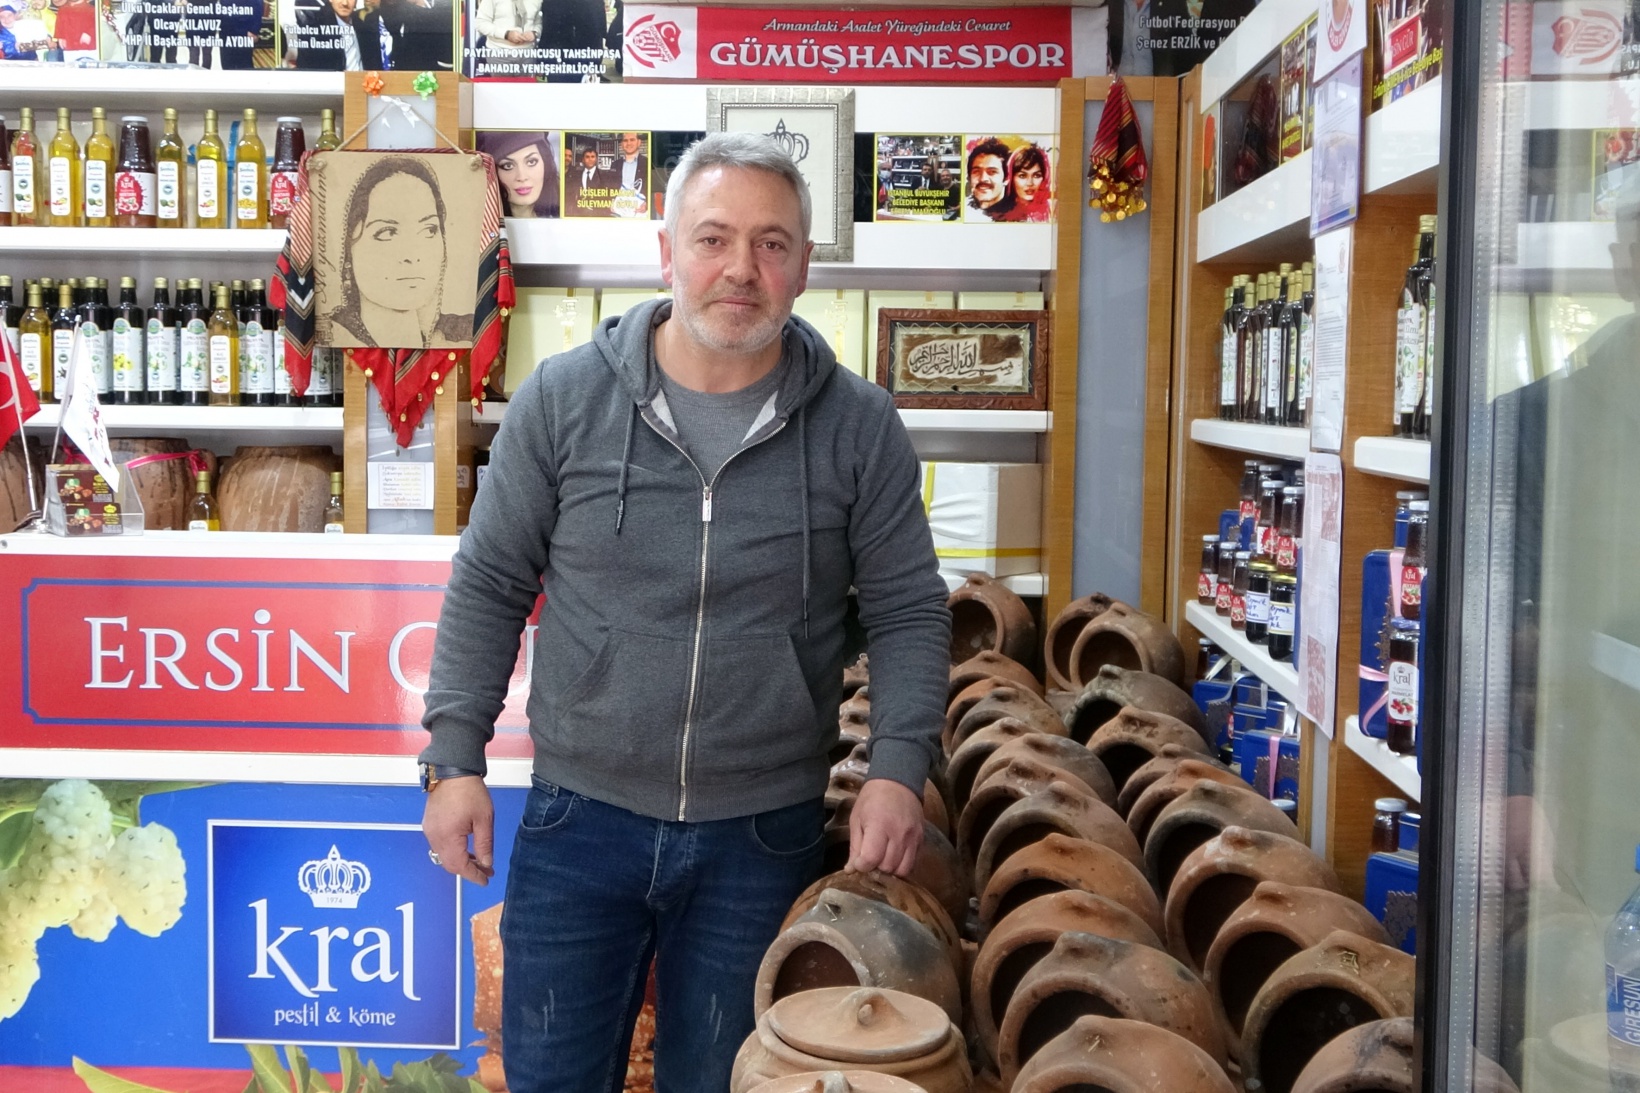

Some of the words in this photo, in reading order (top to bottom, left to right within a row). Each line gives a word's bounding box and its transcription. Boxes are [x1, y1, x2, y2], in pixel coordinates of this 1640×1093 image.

[144, 2, 185, 14] Ocakları
[186, 3, 214, 14] Genel
[215, 3, 254, 16] Başkanı
[153, 18, 180, 32] Olcay
[182, 19, 222, 31] KILAVUZ
[284, 25, 319, 35] Futbolcu
[320, 25, 355, 35] YATTARA
[763, 18, 839, 32] Armandaki
[841, 19, 883, 33] Asalet
[885, 18, 962, 35] Yüreğindeki
[965, 18, 1012, 32] Cesaret
[1139, 16, 1173, 28] Futbol
[1175, 16, 1237, 31] Federasyon
[123, 34, 143, 46] MHP
[153, 34, 192, 48] Başkanı
[193, 35, 224, 47] Nedim
[225, 36, 254, 48] AYDIN
[288, 38, 309, 49] Abim
[310, 37, 333, 49] Ünsal
[334, 38, 350, 49] GÜR
[1171, 35, 1201, 49] ERZİK
[1203, 39, 1216, 49] ve
[464, 46, 509, 58] PAYİTAHT
[511, 49, 562, 59] OYUNCUSU
[563, 46, 621, 60] TAHSİNPAŞA
[709, 36, 1066, 74] GÜMÜŞHANESPOR
[478, 63, 521, 74] BAHADIR
[522, 61, 607, 76] YENİŞEHİRLİOĞLU
[84, 608, 356, 694] ERSİN
[1393, 671, 1411, 685] kral
[247, 898, 422, 1002] kral
[274, 1002, 319, 1027] pestil
[325, 1006, 342, 1024] &
[348, 1006, 396, 1027] köme
